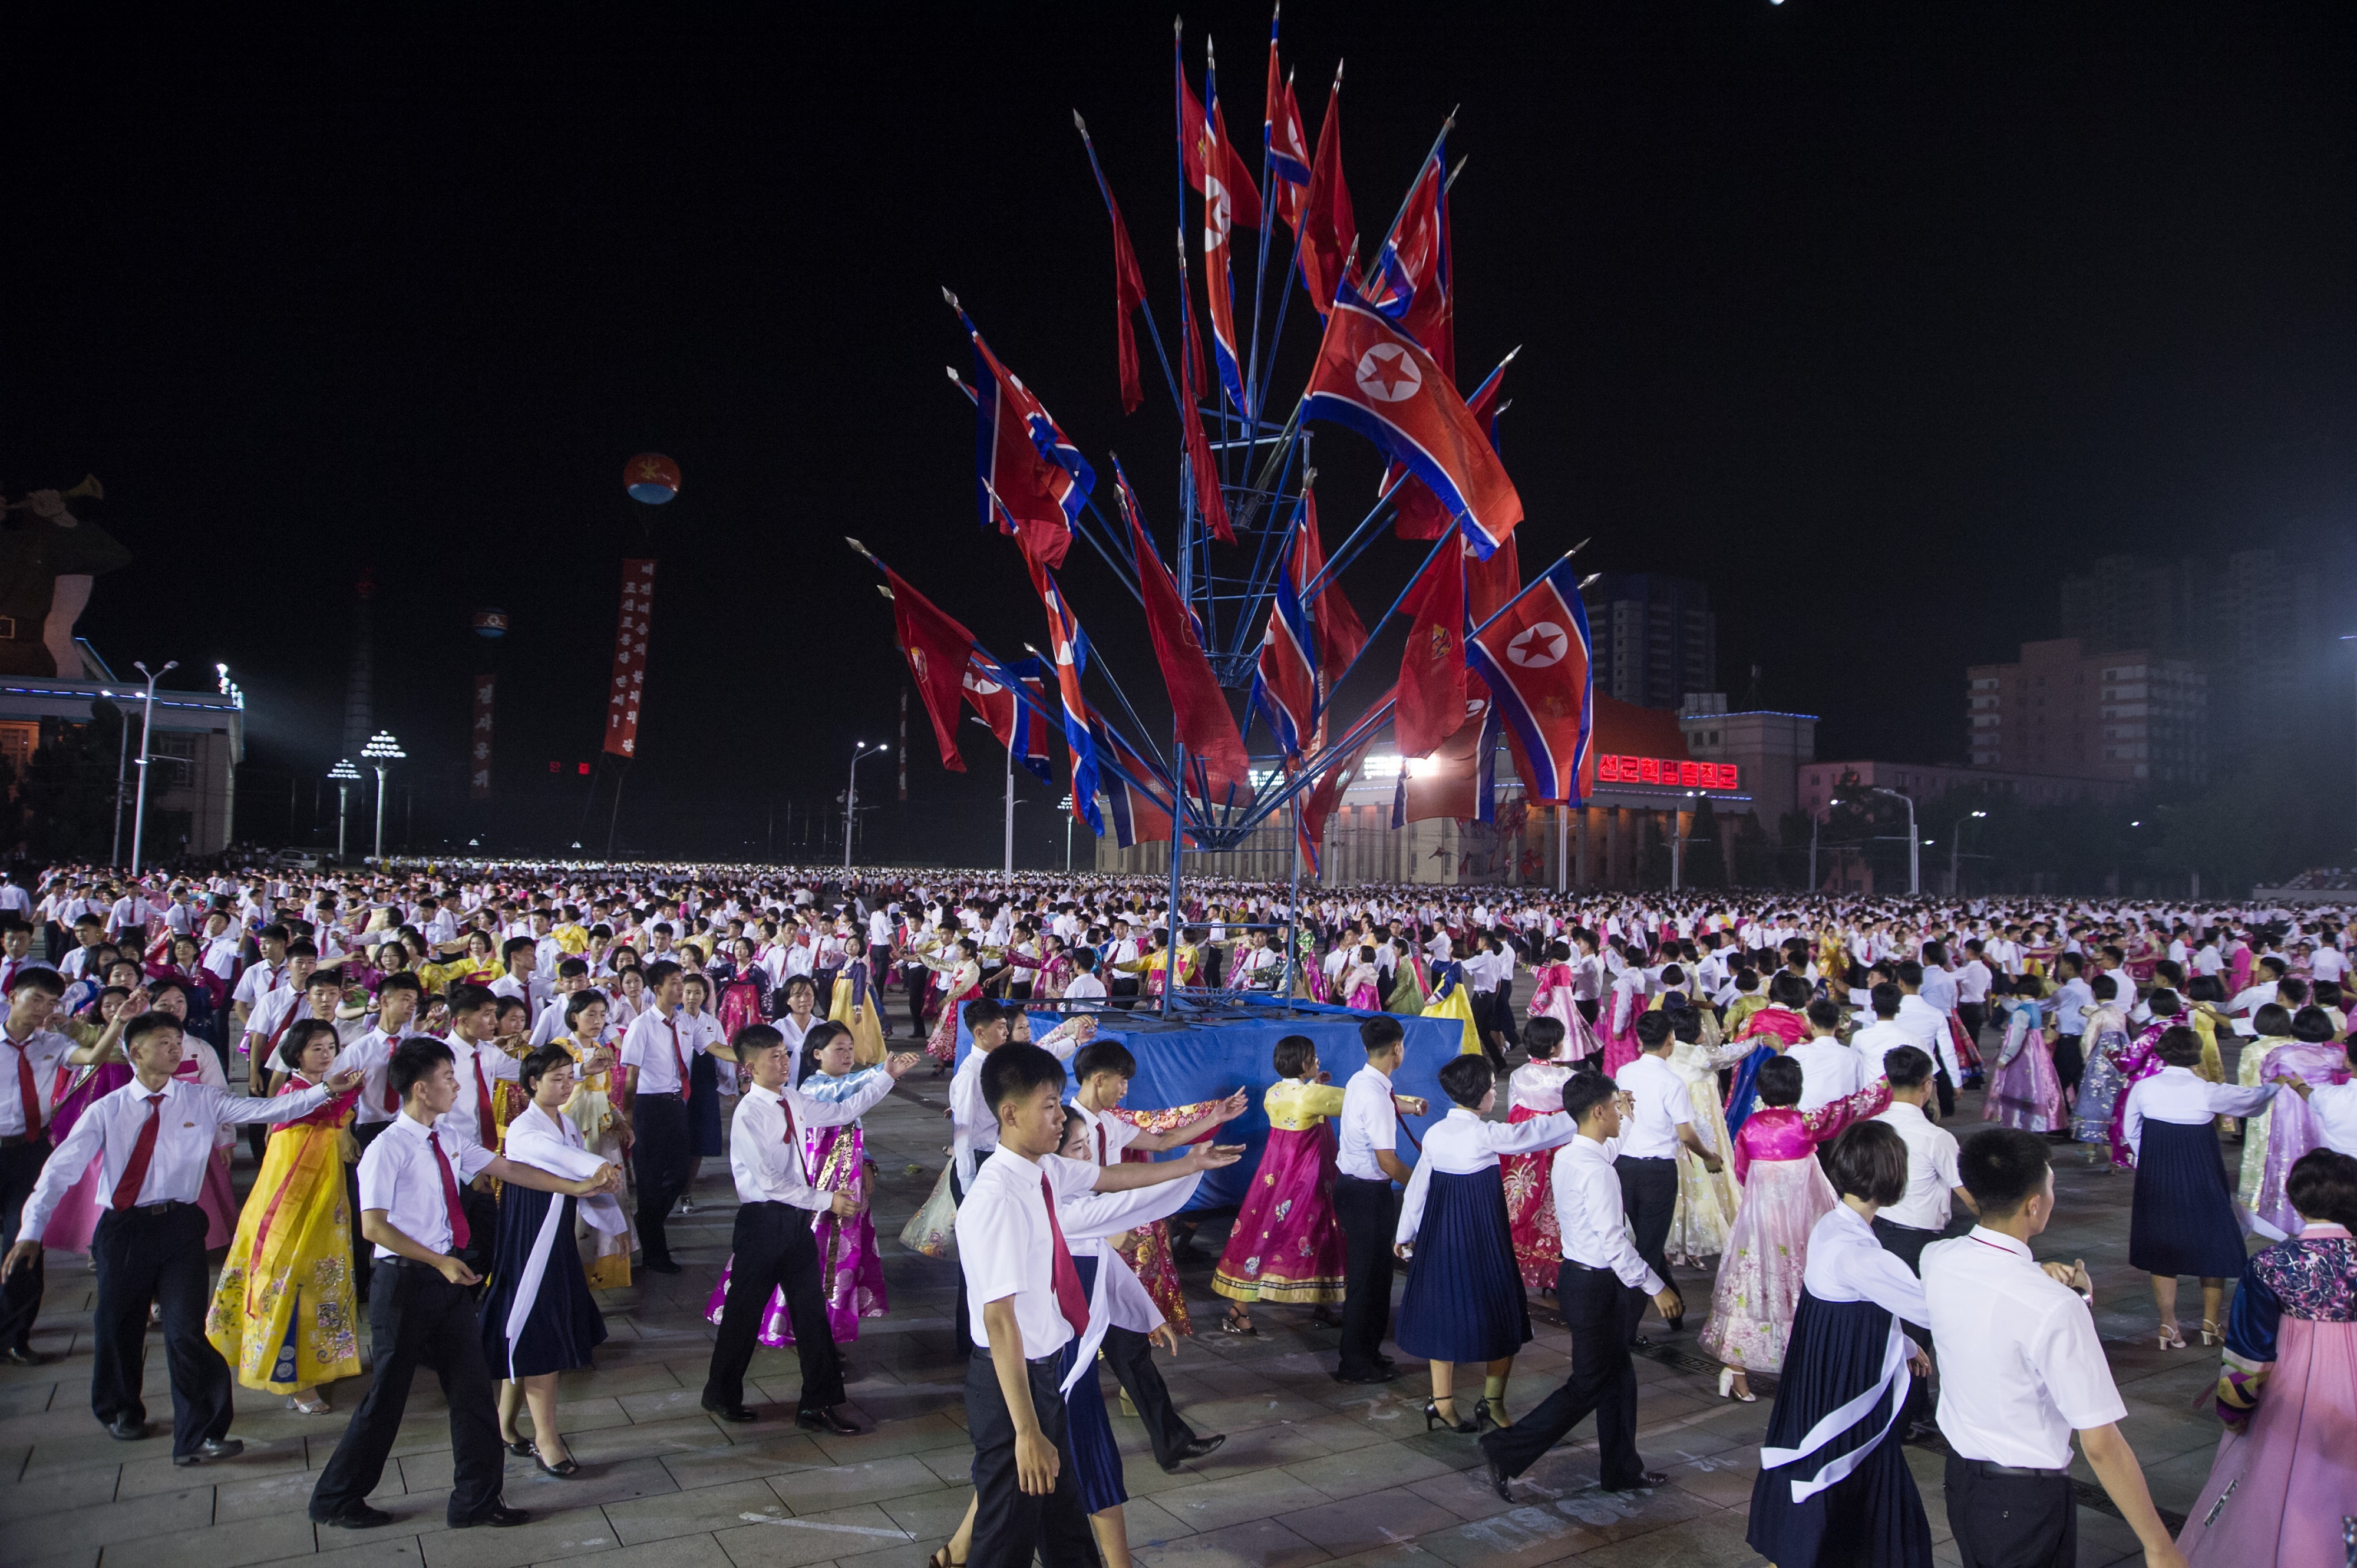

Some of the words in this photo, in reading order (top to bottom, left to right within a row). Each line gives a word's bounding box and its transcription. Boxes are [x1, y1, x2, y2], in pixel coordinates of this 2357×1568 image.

[618, 582, 637, 665] 조선로동당
[622, 738, 635, 752] 당
[1599, 754, 1737, 789] 선군혁명총진군
